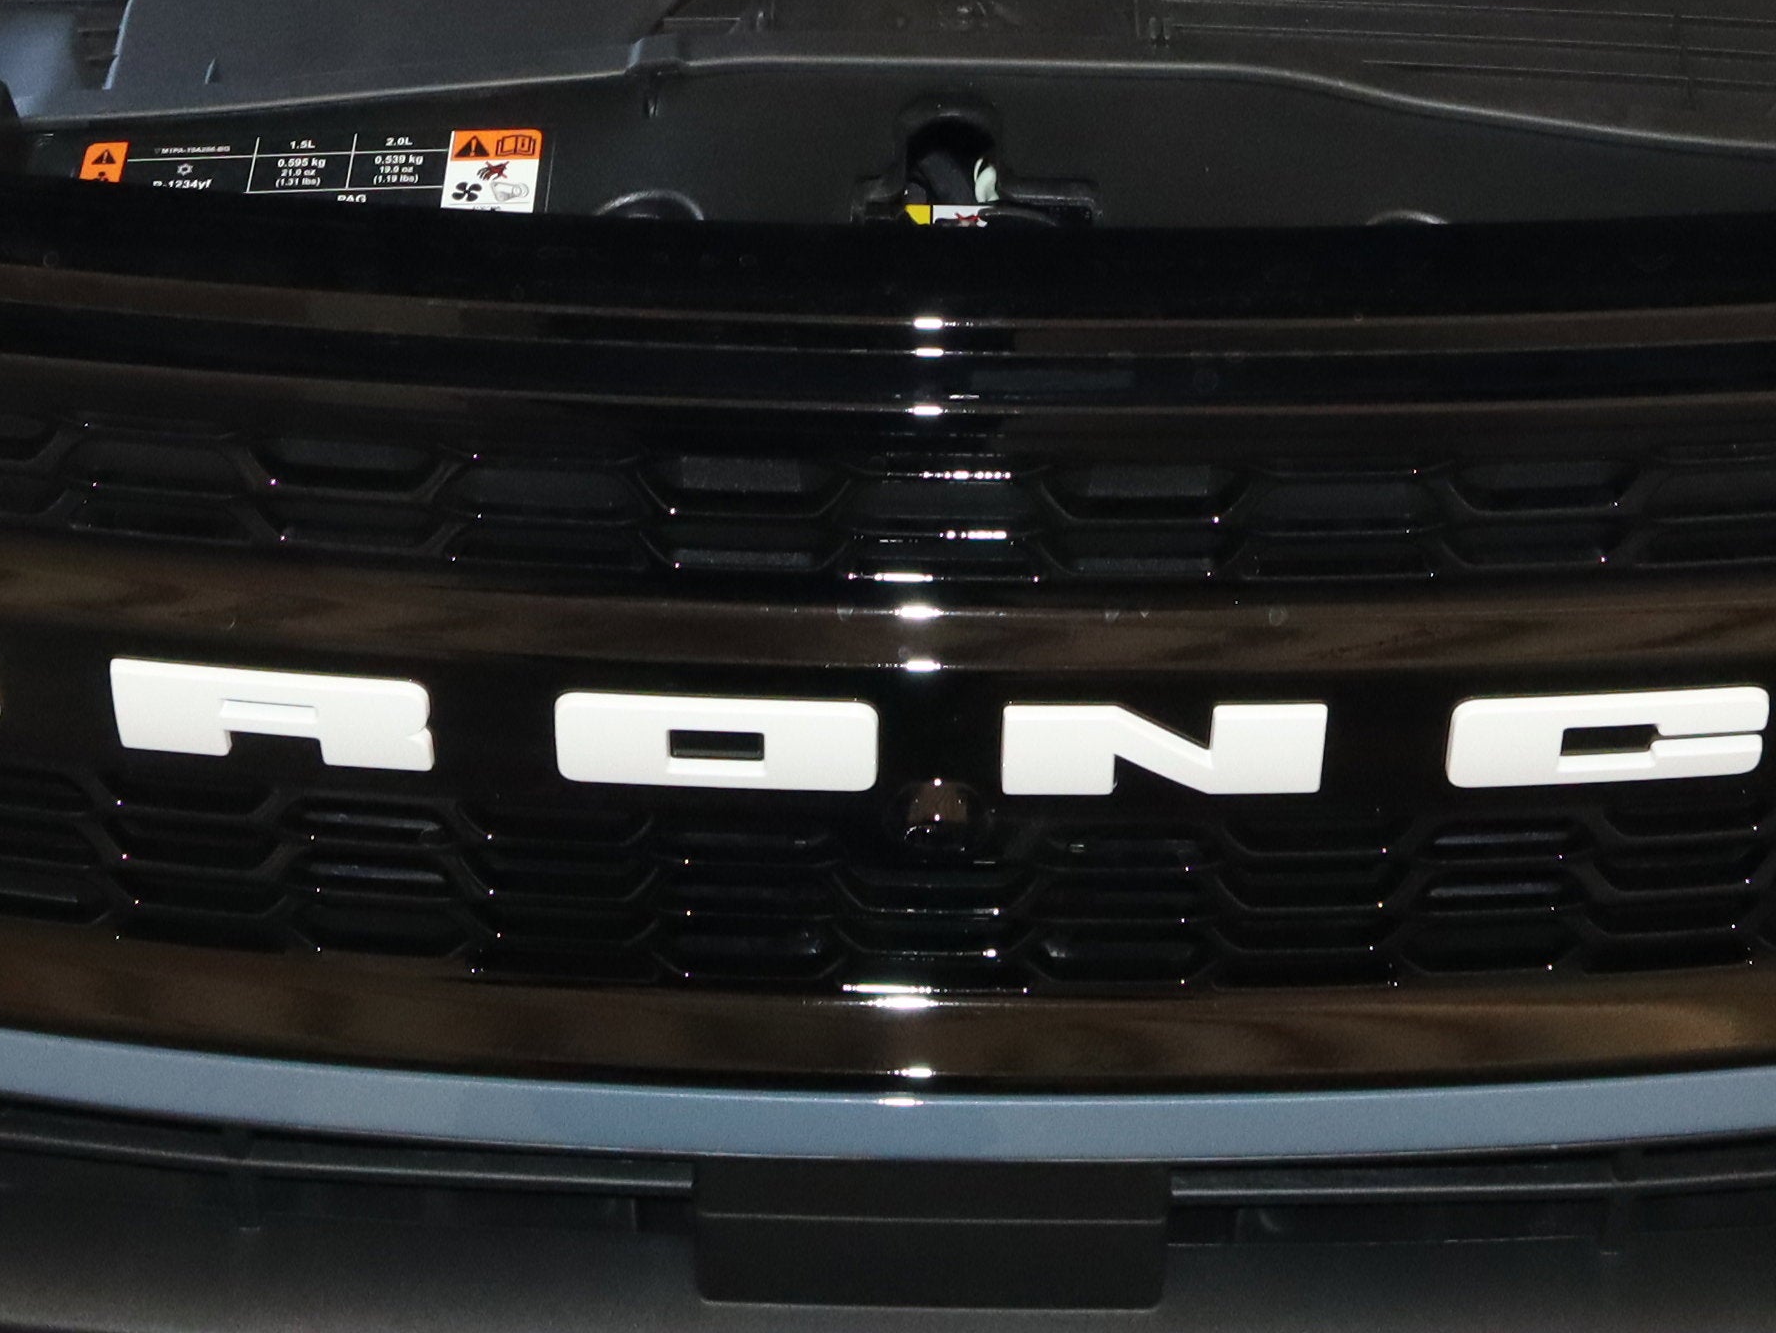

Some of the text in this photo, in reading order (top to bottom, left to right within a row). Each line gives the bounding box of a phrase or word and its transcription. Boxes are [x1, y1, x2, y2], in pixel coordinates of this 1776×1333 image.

[289, 140, 316, 150] 1.5L
[385, 136, 413, 147] 2.0L
[277, 157, 326, 169] 0.595 kg
[374, 154, 424, 165] 0.539 kg
[281, 169, 301, 177] 21.0
[379, 166, 399, 174] 19.0
[152, 179, 213, 190] R-1234yf
[276, 176, 321, 188] (1.31 lbs)
[373, 174, 419, 185] (1.19 lbs)
[337, 194, 367, 203] PAG
